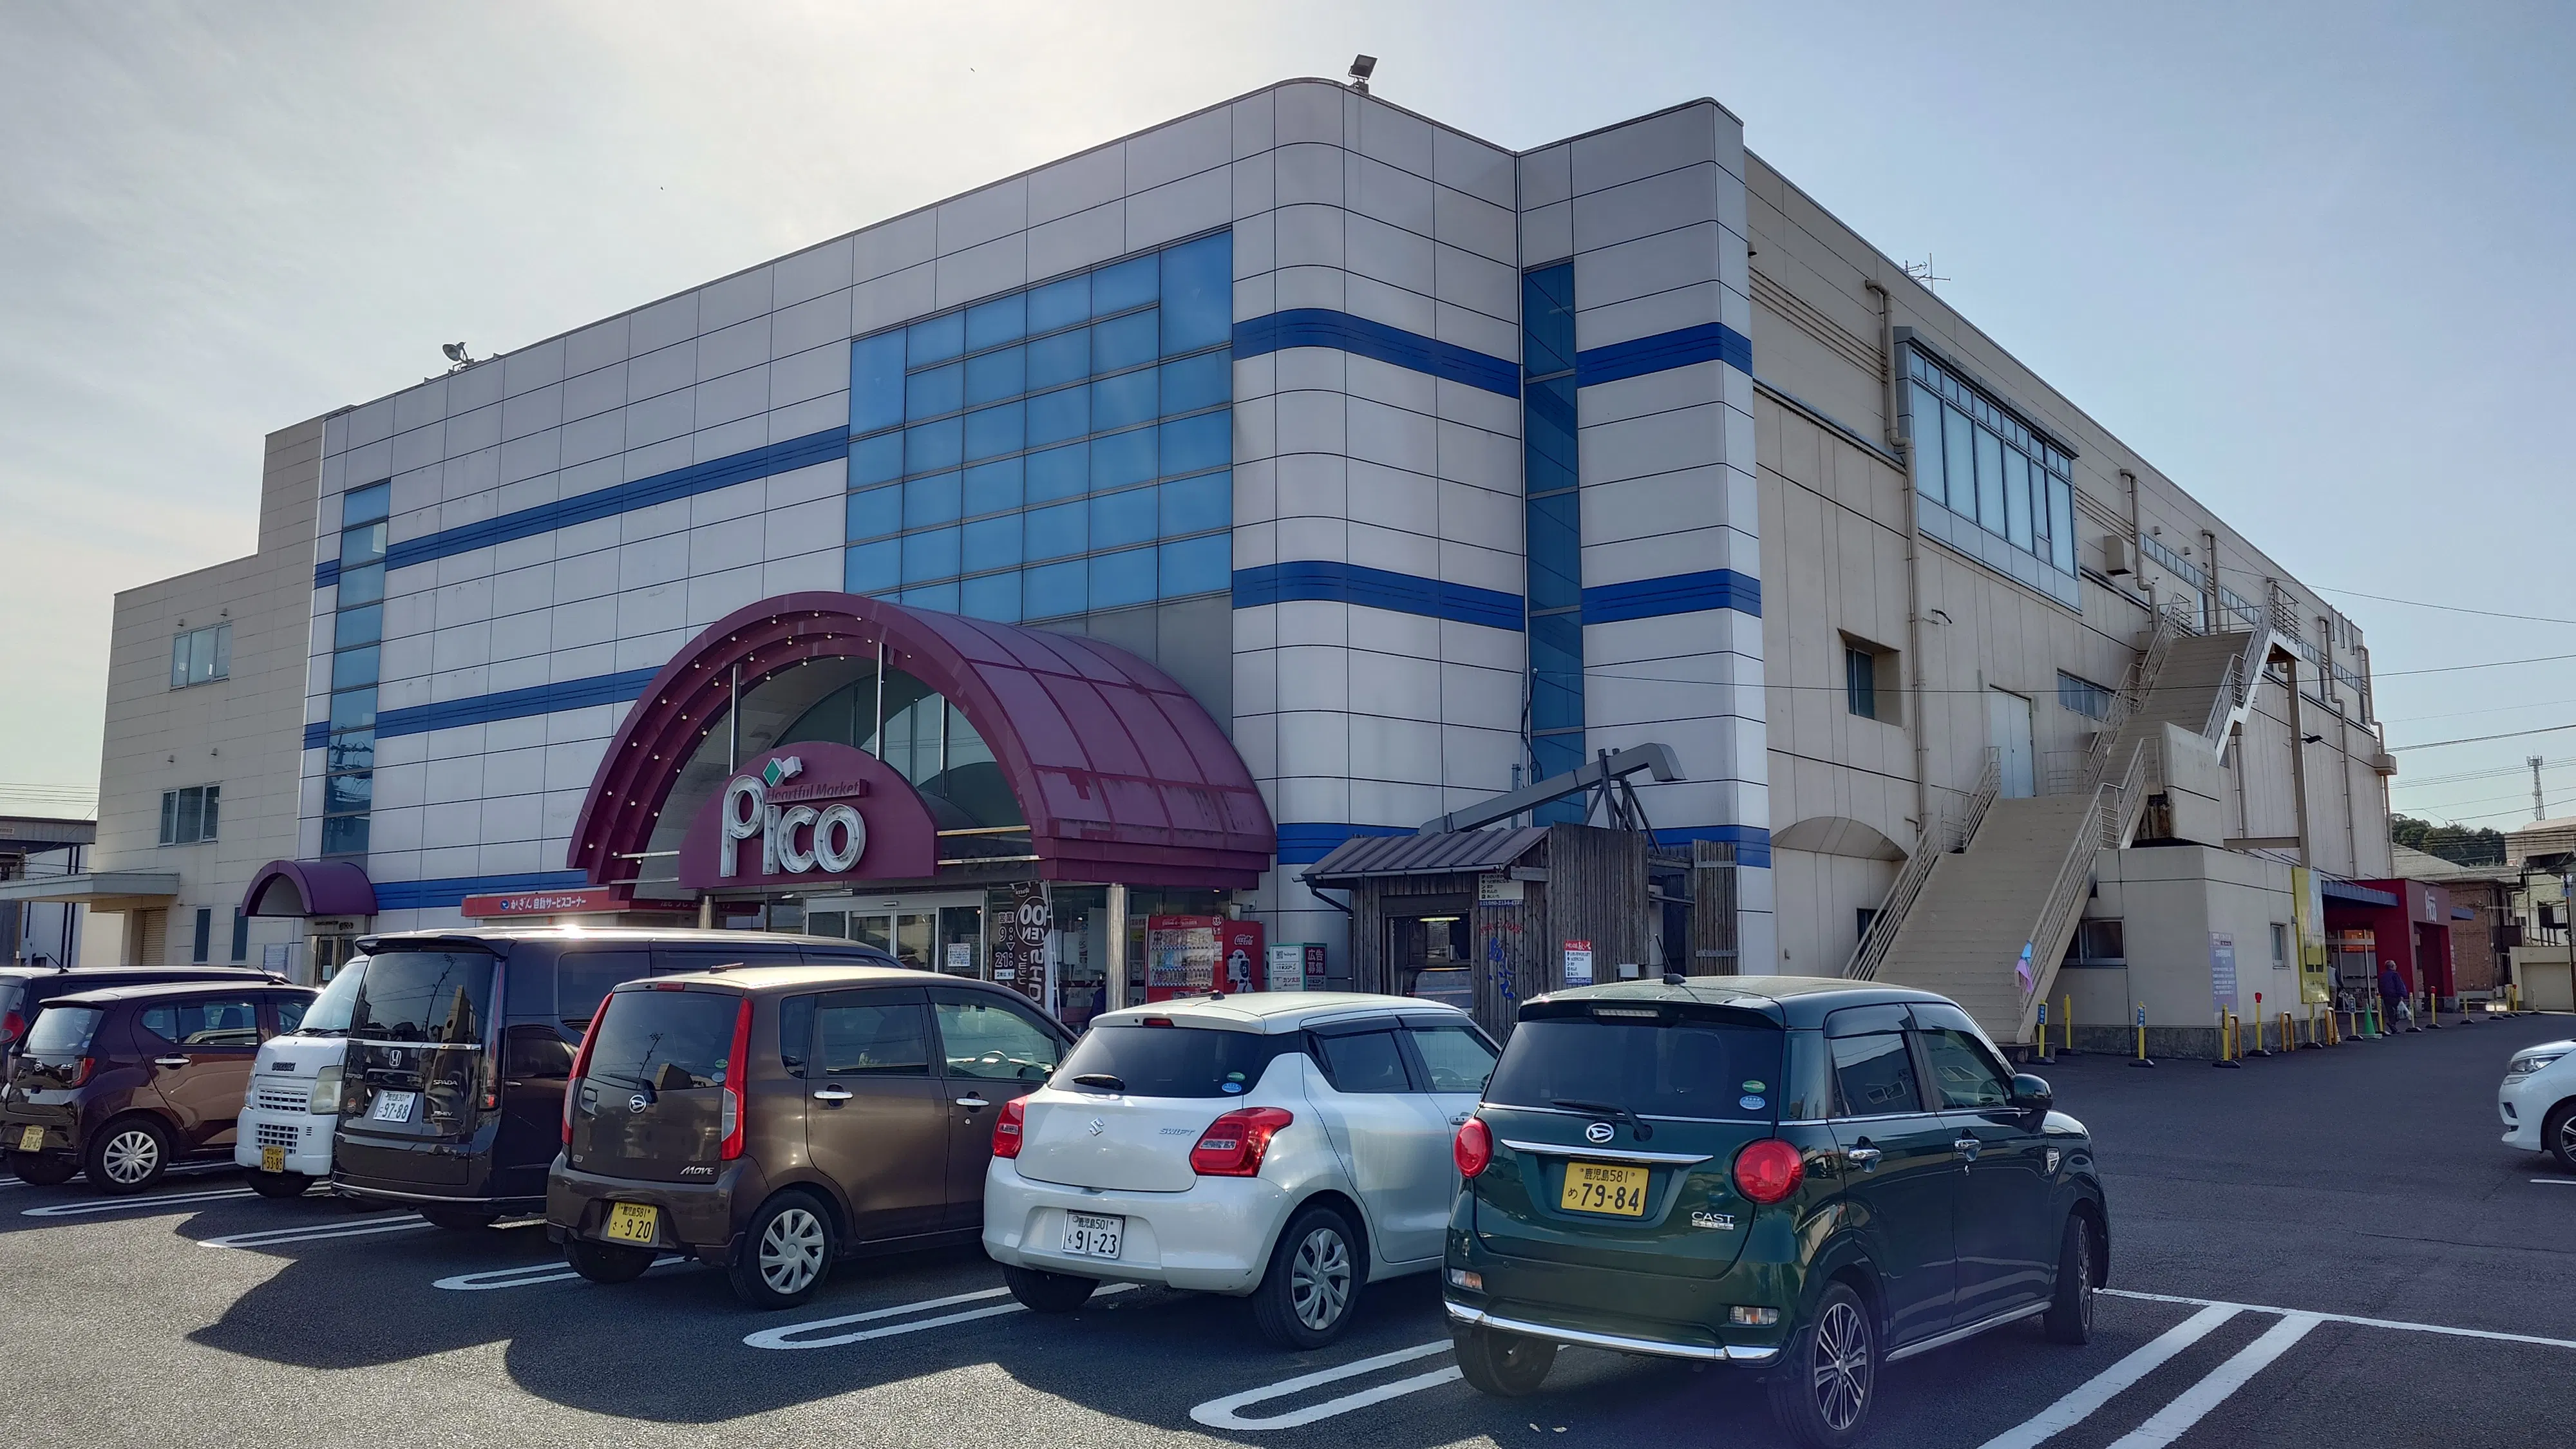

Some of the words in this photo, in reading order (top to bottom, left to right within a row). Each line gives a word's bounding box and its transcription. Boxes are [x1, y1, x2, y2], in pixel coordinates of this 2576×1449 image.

[767, 784, 813, 802] Heartful
[816, 781, 859, 797] Market
[511, 898, 532, 911] かぎん
[533, 896, 587, 909] 自動サービスコーナー
[998, 926, 1014, 942] 9:
[1307, 949, 1323, 961] 広告
[1307, 961, 1323, 974] 募集
[382, 1103, 409, 1119] 97-88
[679, 1166, 715, 1175] MOVE
[1584, 1168, 1628, 1183] 鹿児島581
[1568, 1188, 1578, 1200] め
[1581, 1183, 1640, 1211] 79-84
[1077, 1217, 1108, 1231] 鹿児島501
[1691, 1211, 1734, 1224] CAST
[1075, 1230, 1117, 1254] 91-23
